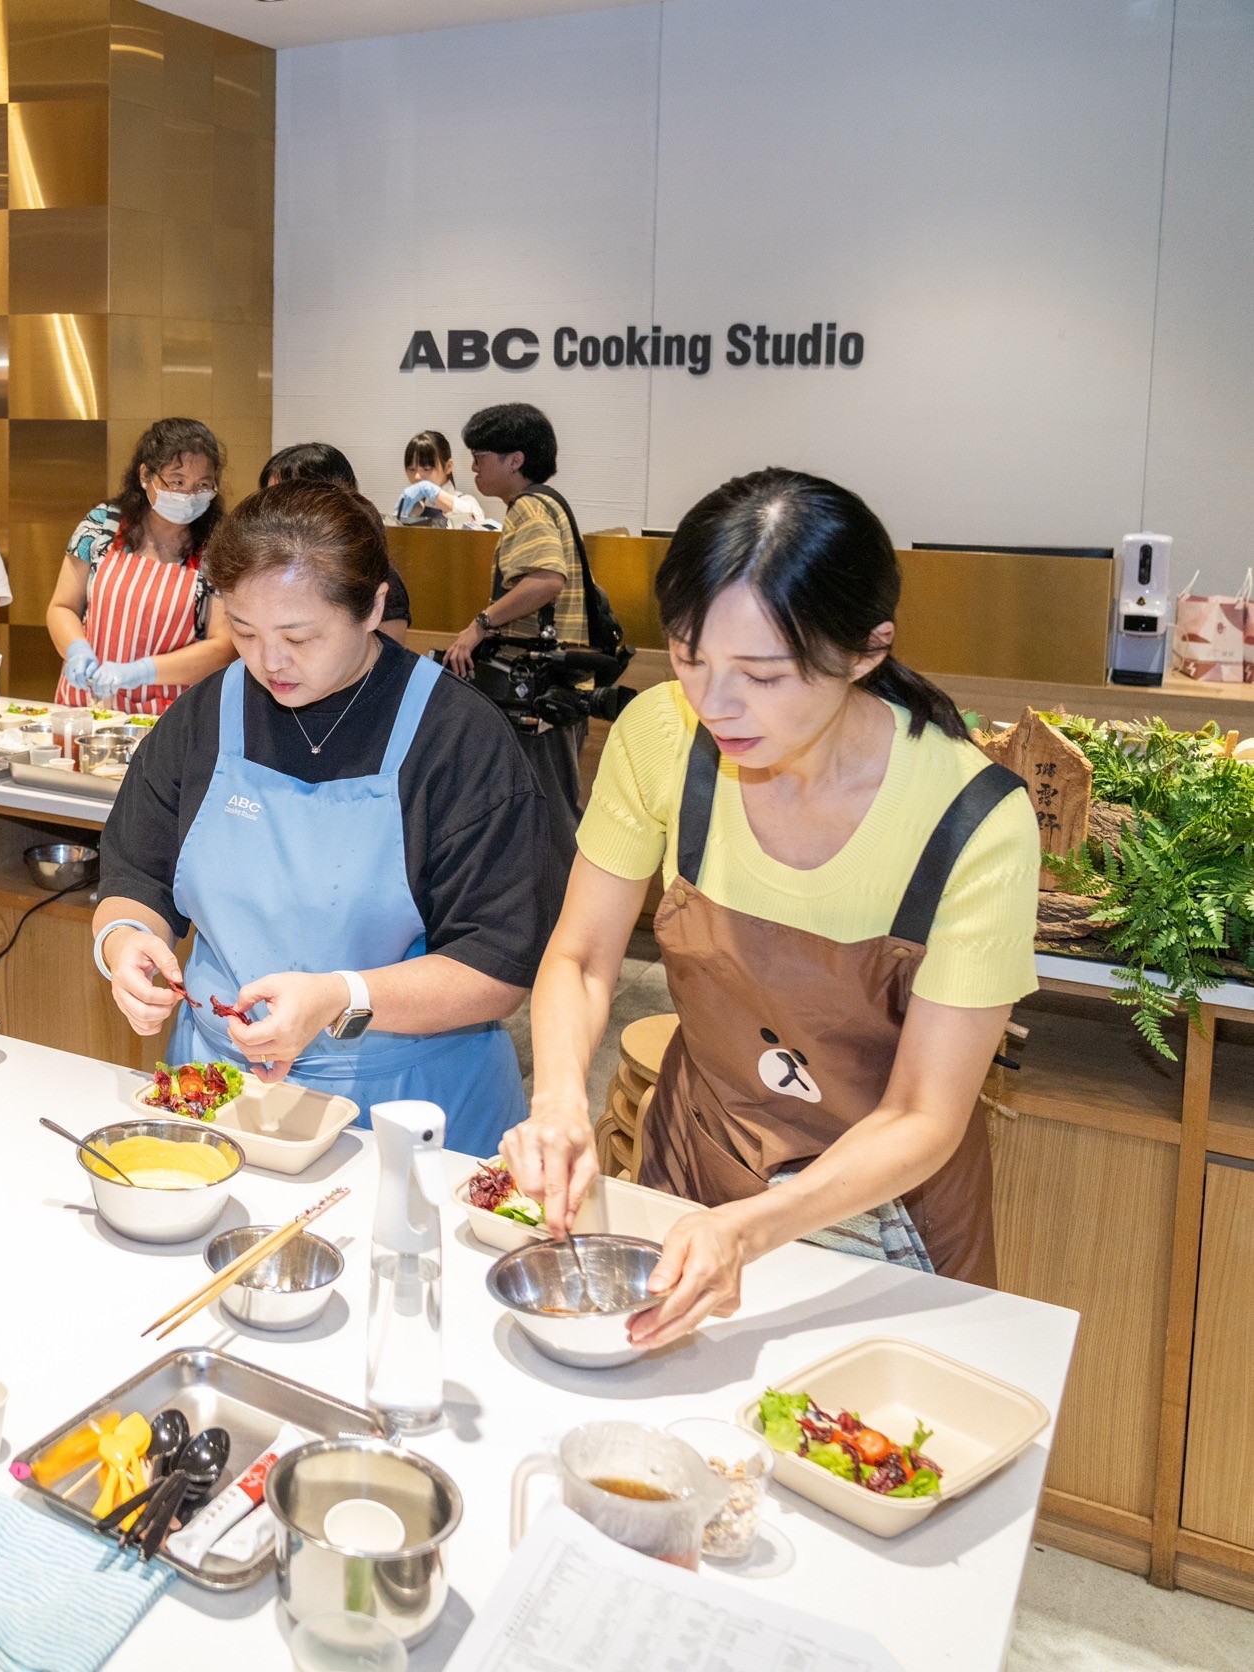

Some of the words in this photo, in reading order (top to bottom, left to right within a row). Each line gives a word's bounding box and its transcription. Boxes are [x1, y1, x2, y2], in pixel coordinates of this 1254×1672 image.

[399, 328, 540, 371] ABC
[553, 326, 711, 376] Cooking
[726, 323, 865, 368] Studio
[228, 794, 262, 813] ABC
